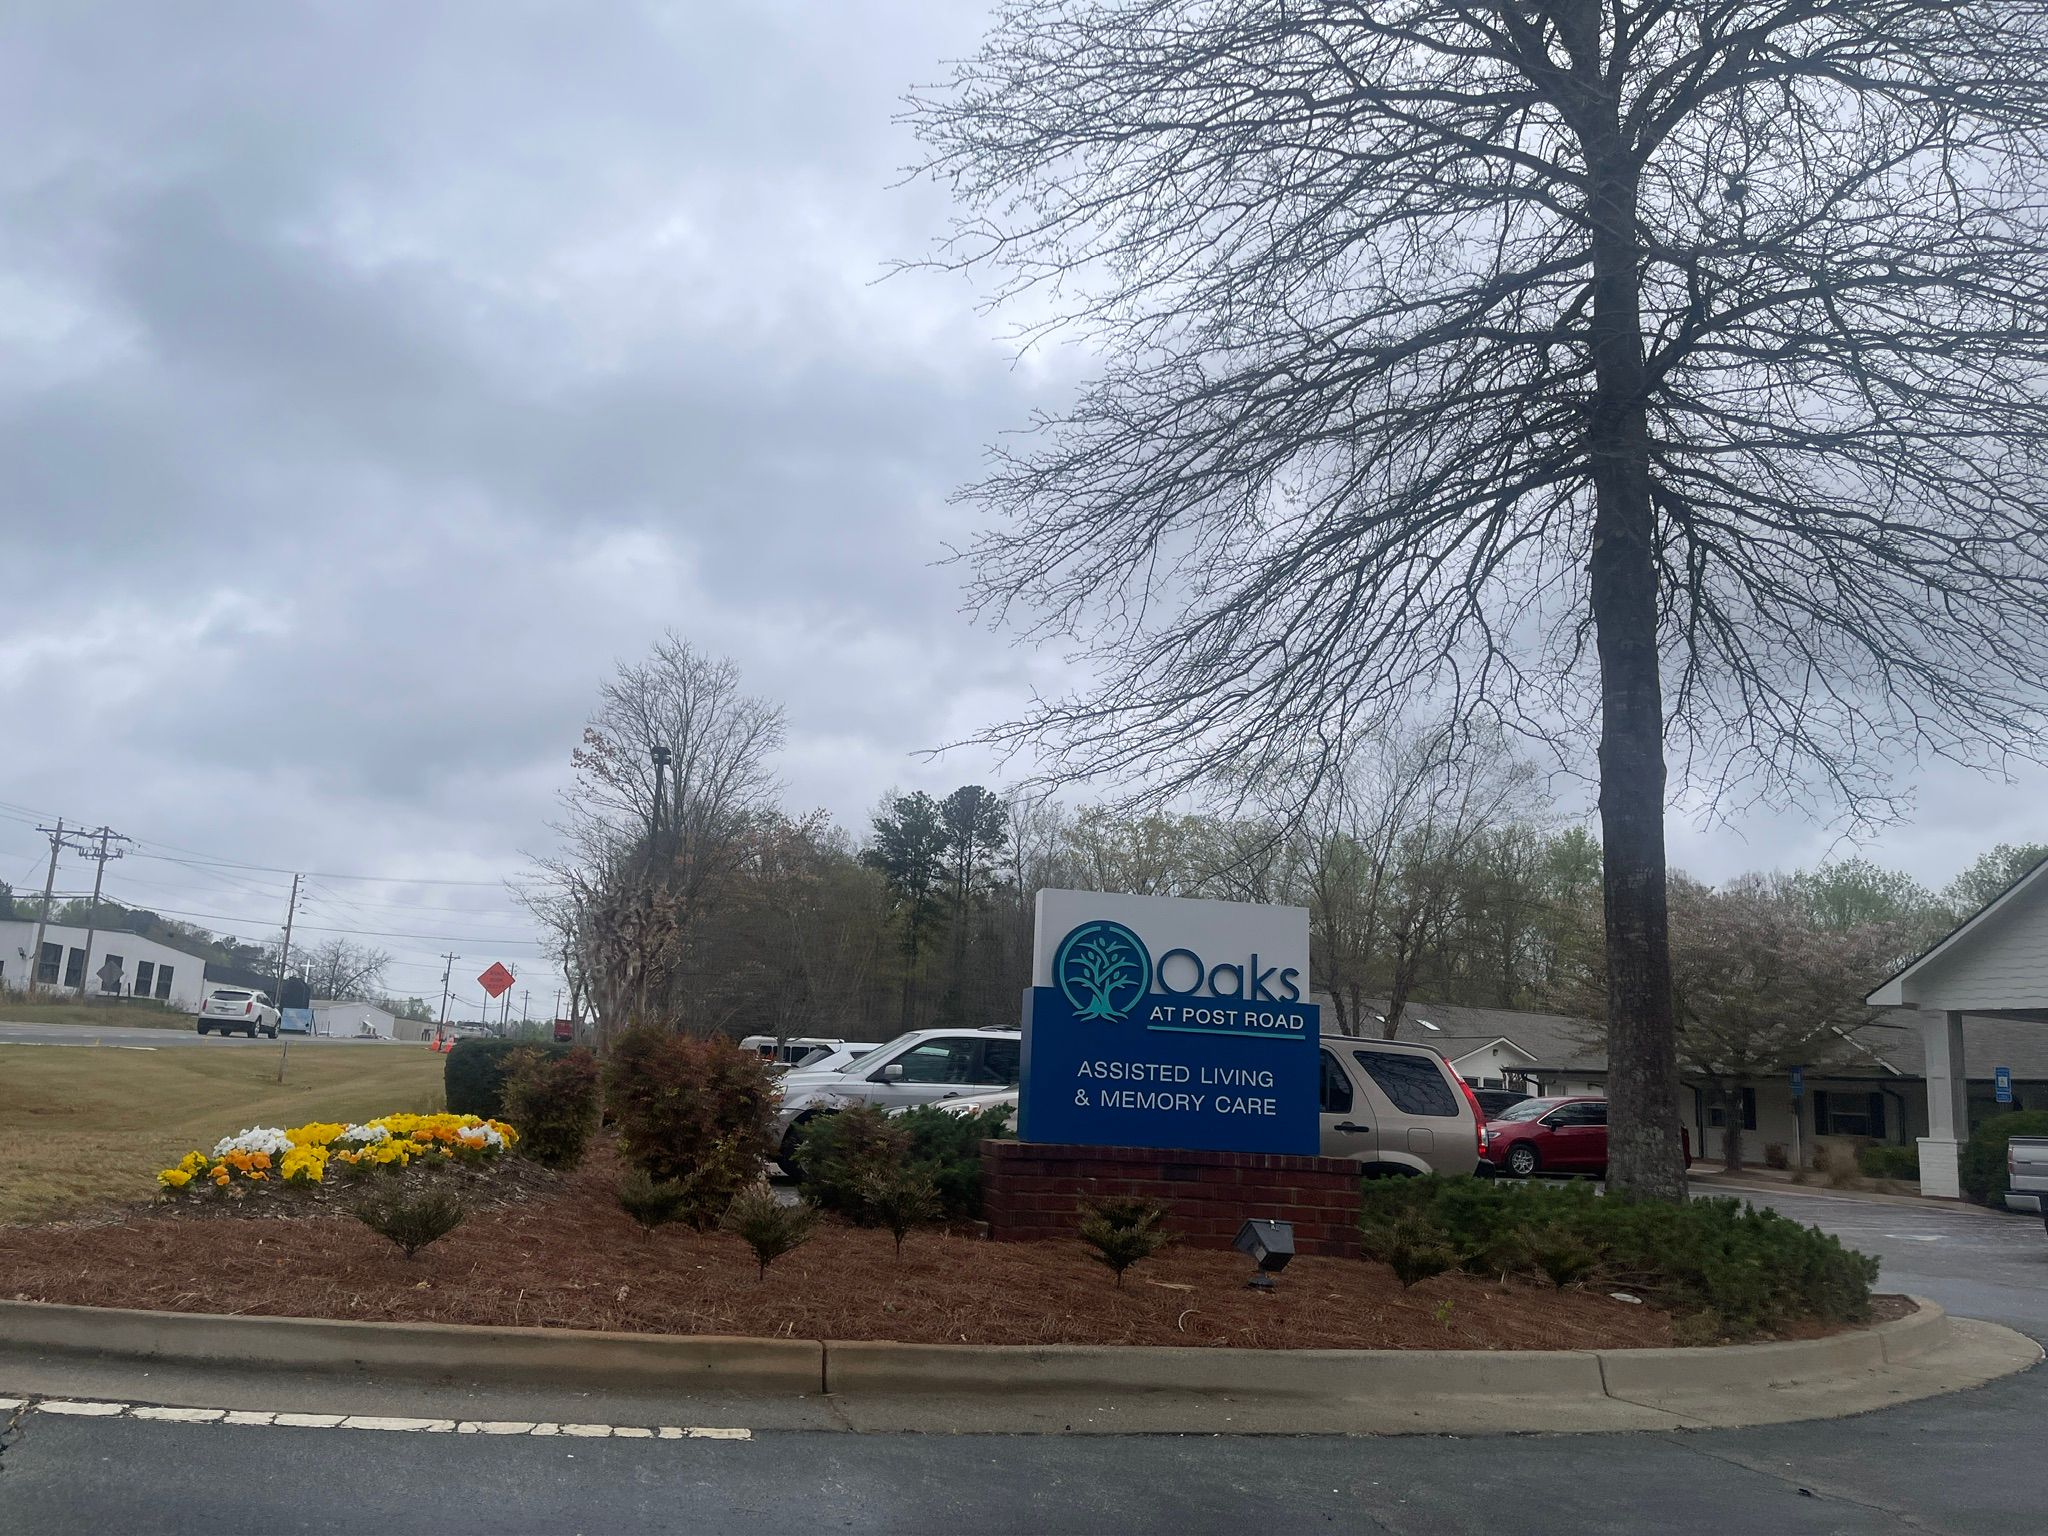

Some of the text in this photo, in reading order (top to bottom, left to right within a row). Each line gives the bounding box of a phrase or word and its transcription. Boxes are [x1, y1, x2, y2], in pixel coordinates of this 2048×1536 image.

[1156, 948, 1300, 1003] Oaks
[1149, 1006, 1304, 1030] AT POST ROAD
[1077, 1060, 1274, 1089] ASSISTED LIVING
[1074, 1088, 1277, 1116] & MEMORY CARE
